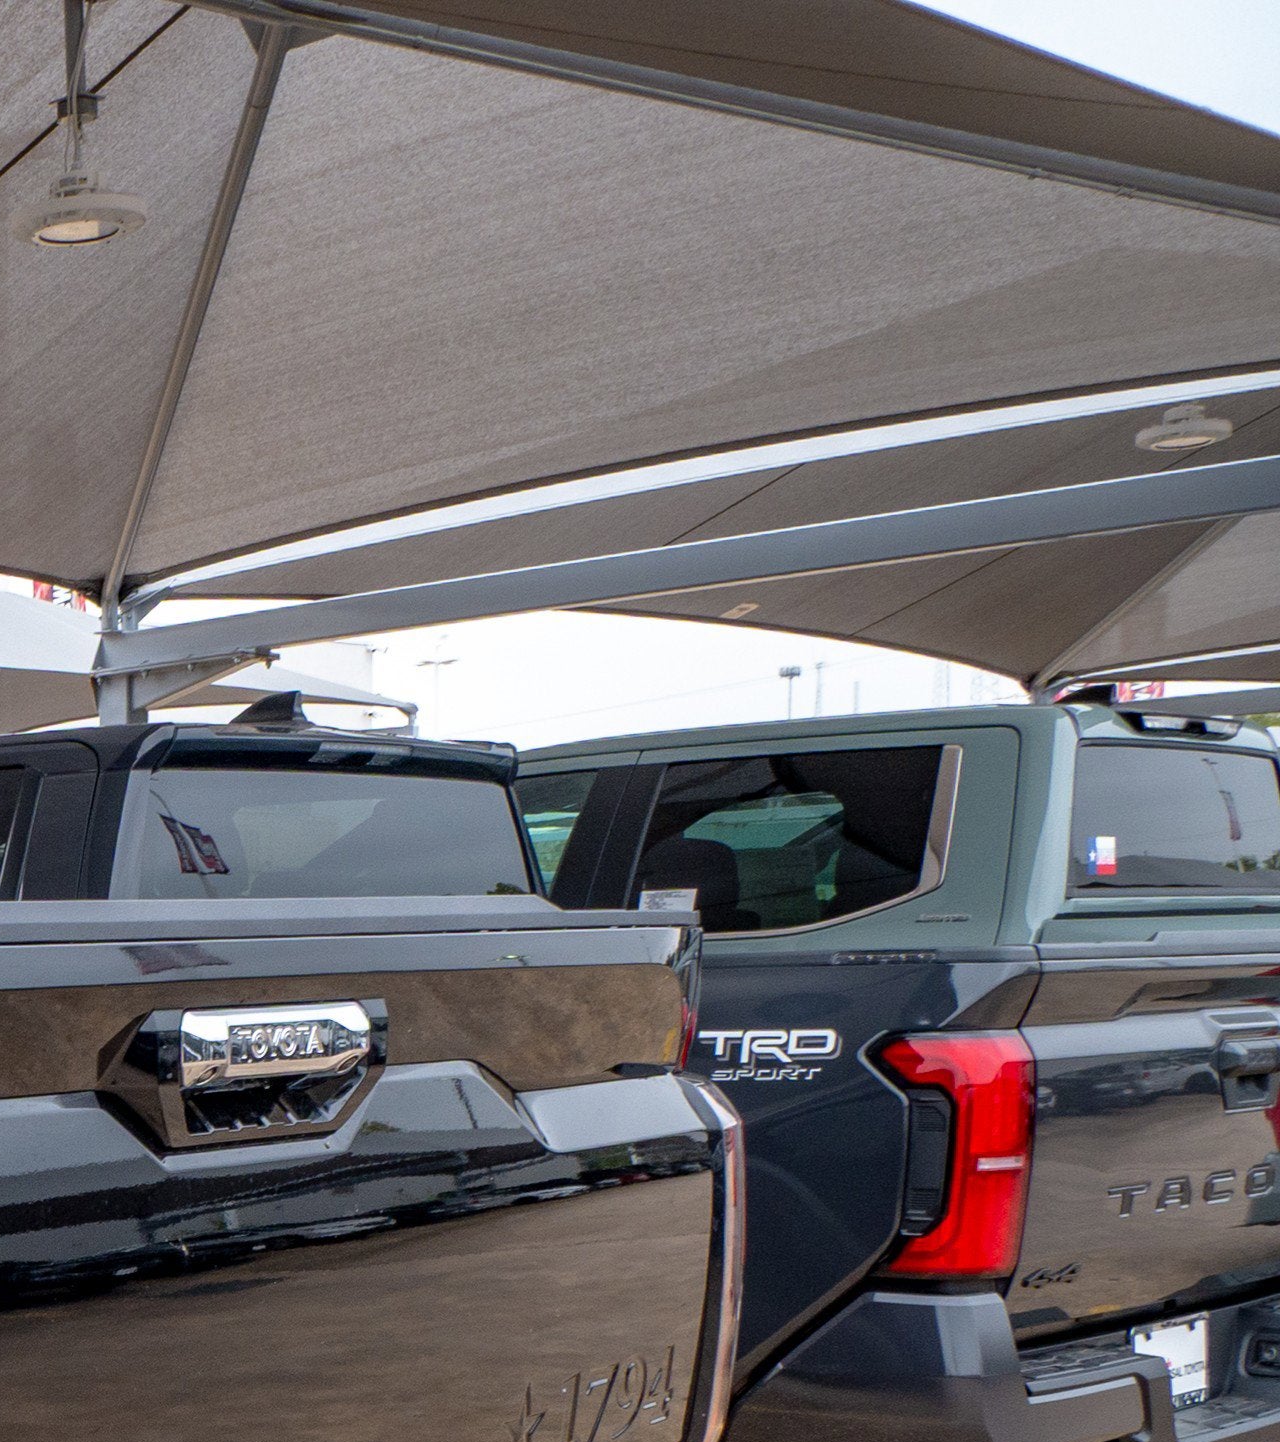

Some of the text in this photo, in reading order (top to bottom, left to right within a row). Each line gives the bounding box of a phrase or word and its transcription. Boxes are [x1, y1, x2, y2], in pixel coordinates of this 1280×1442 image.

[232, 1022, 324, 1064] TOYOTA
[698, 1029, 842, 1067] TRD
[711, 1067, 821, 1081] SPORT
